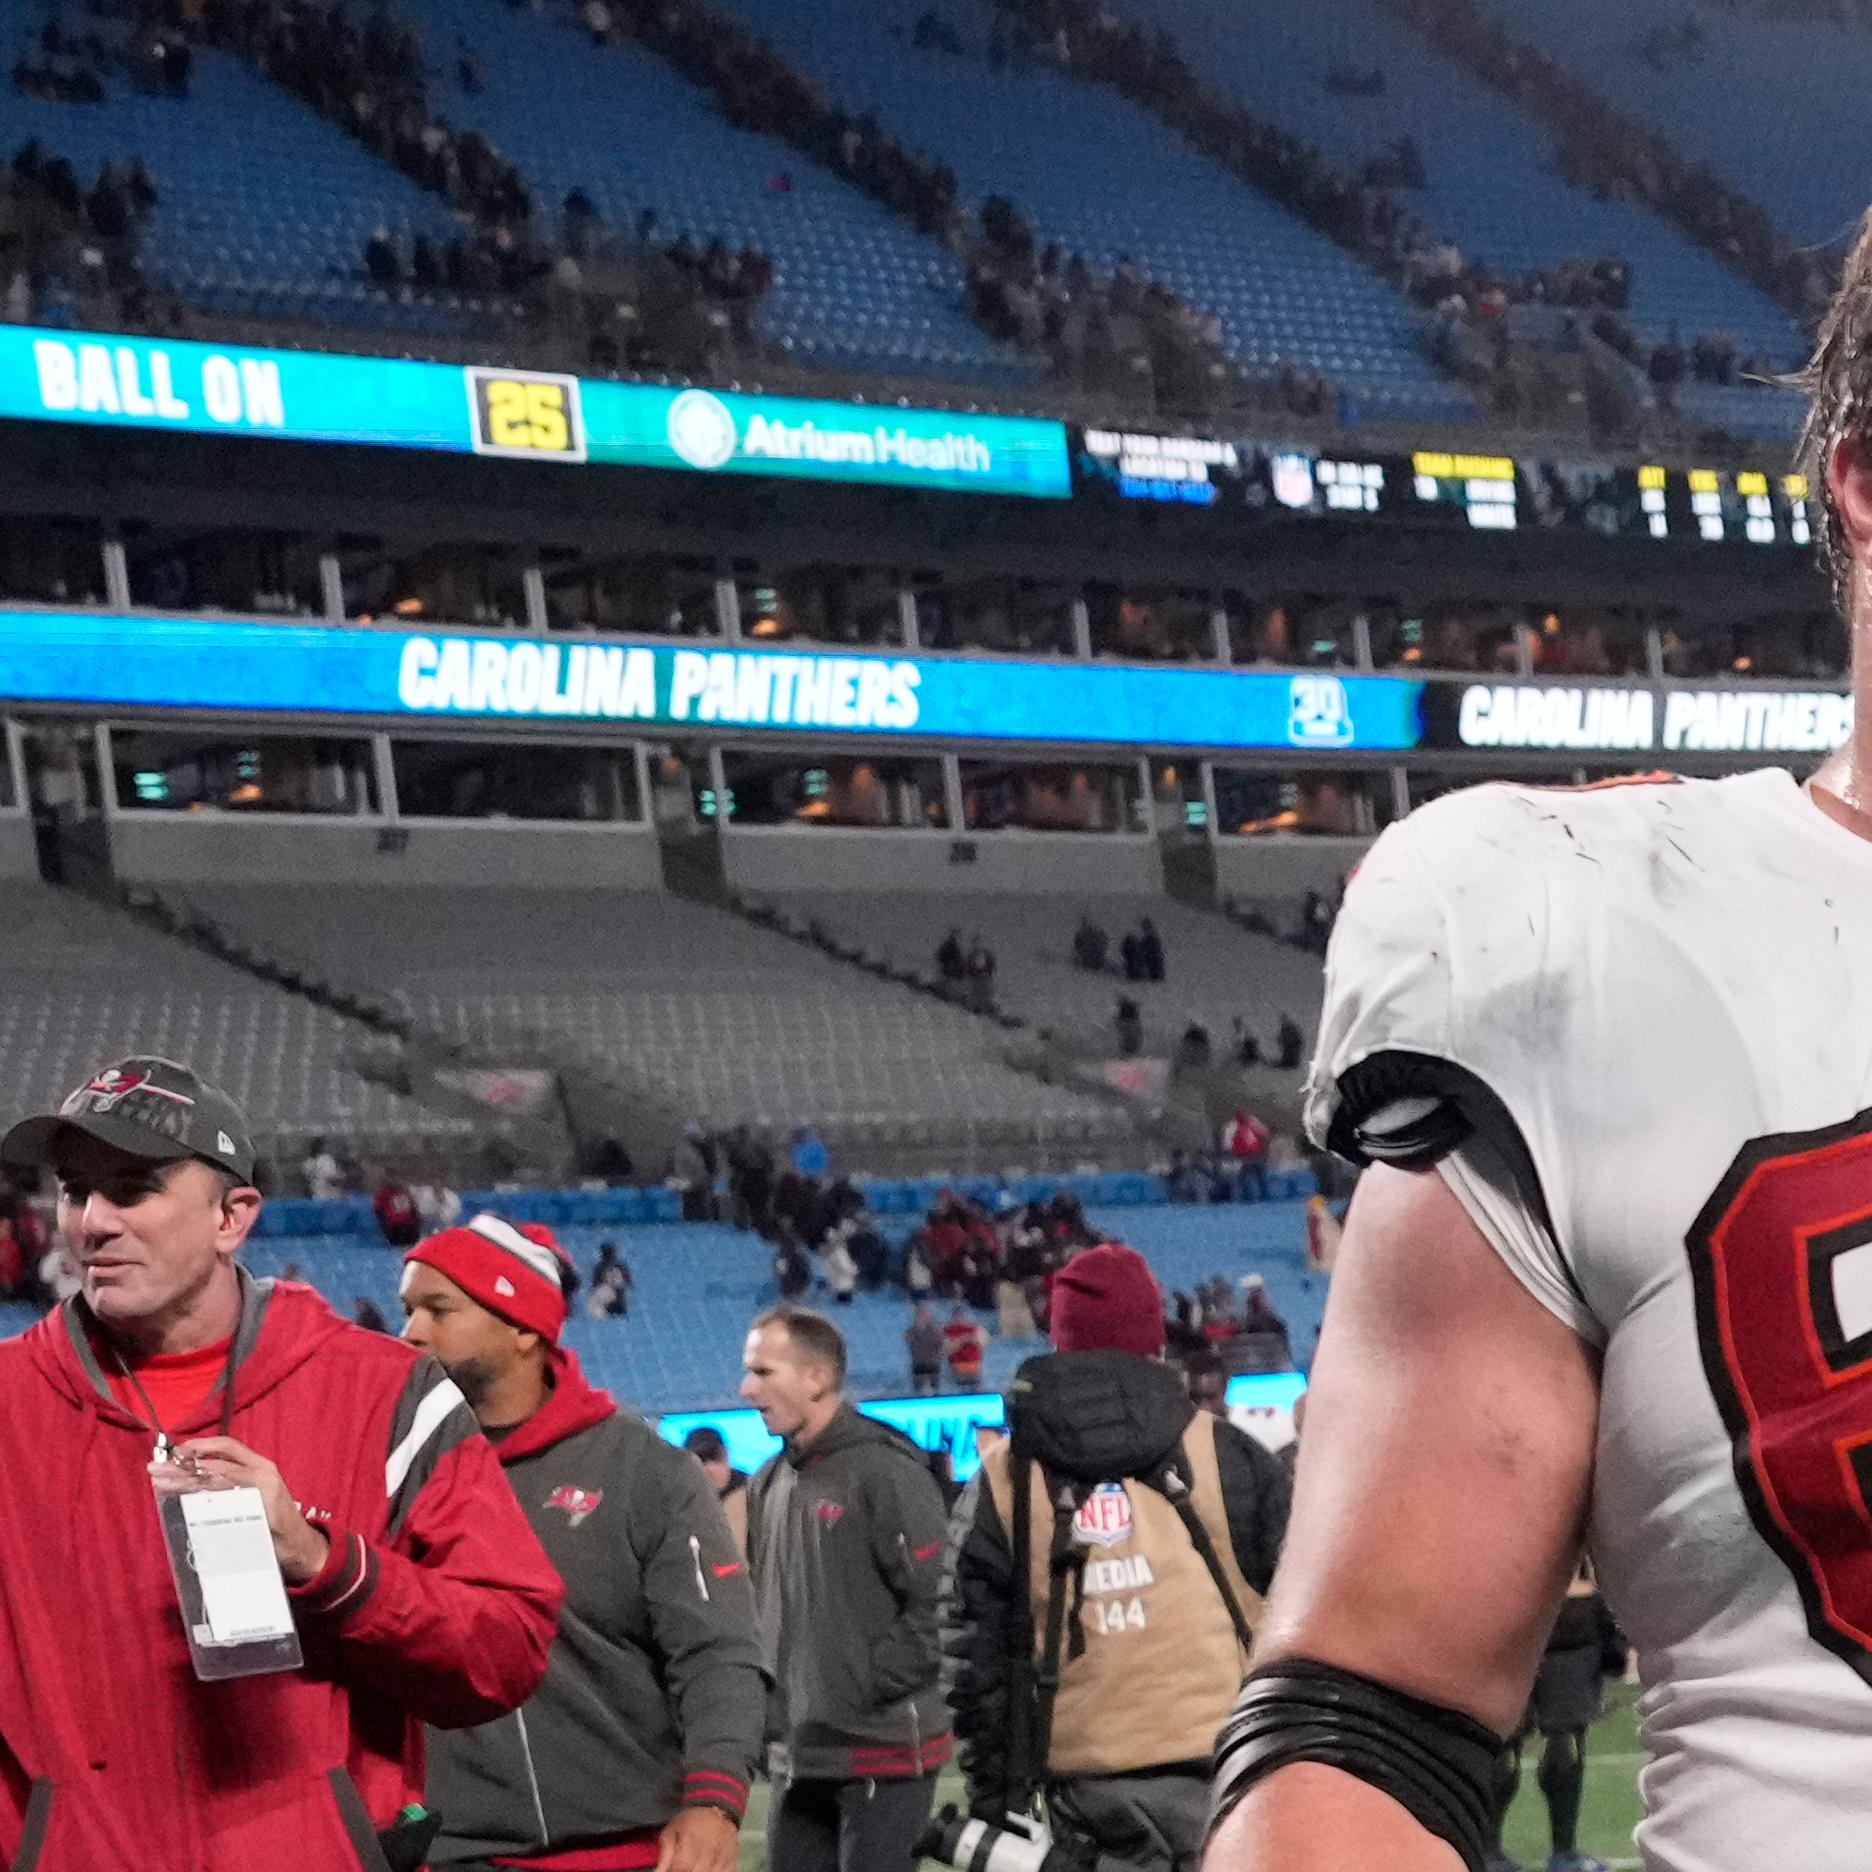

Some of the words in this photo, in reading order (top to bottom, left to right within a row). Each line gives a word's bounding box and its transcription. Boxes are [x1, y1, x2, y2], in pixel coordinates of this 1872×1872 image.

[32, 338, 191, 421] BALL
[200, 353, 285, 430] ON
[486, 380, 569, 450] 25
[744, 413, 874, 464] Atrium
[877, 425, 990, 472] Health
[398, 638, 657, 718] CAROLINA
[668, 651, 921, 729] PANTHERS
[1458, 685, 1655, 749] CAROLINA
[1080, 1497, 1132, 1531] NFL
[1096, 1597, 1145, 1634] 144
